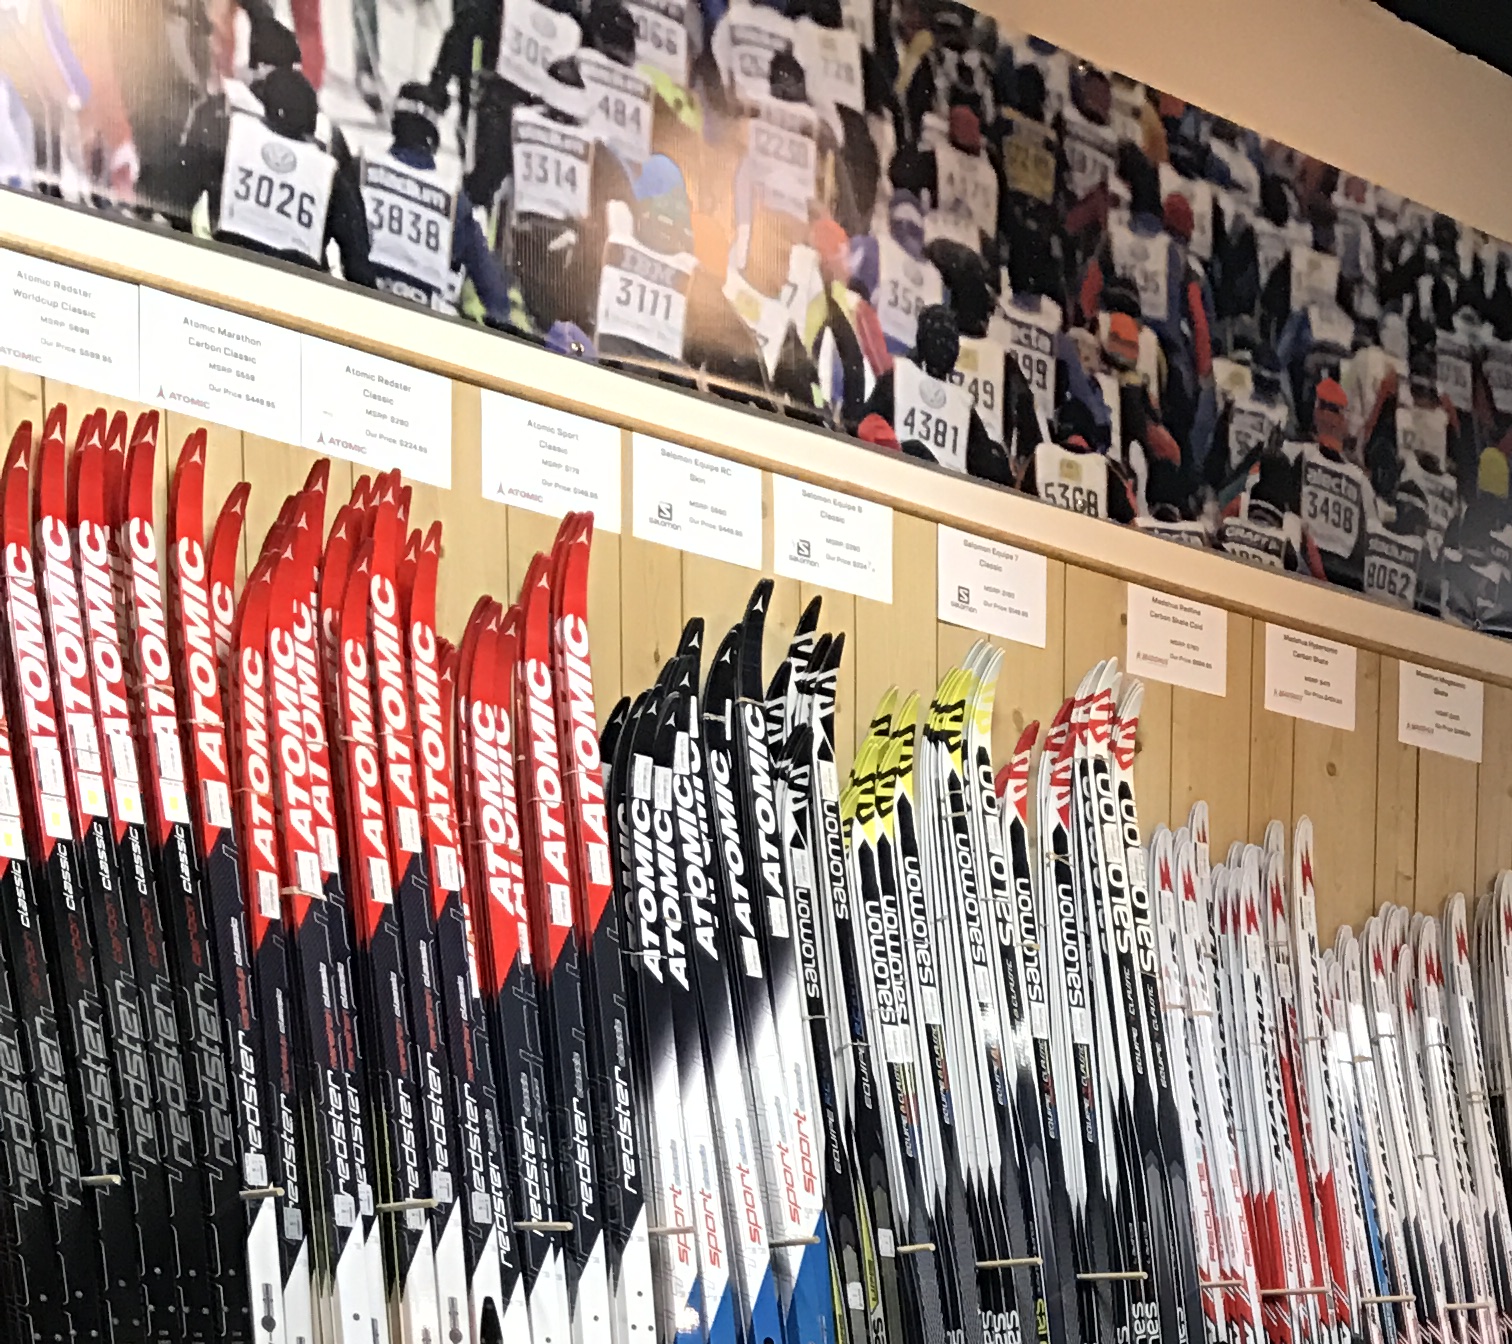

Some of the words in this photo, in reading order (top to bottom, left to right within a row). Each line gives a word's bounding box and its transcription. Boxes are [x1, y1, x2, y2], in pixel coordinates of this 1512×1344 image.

[234, 165, 316, 230] 3026
[521, 151, 577, 193] 3314
[368, 197, 441, 252] 3838
[13, 288, 59, 309] Worldcup
[61, 301, 97, 319] Classic
[16, 270, 51, 287] Atomic
[53, 279, 92, 299] Redster
[183, 316, 215, 334] Atomic
[217, 326, 262, 347] Marathon
[616, 277, 672, 321] 3111
[168, 391, 211, 410] ATOMIC
[188, 337, 222, 354] Carbon
[224, 346, 257, 365] Classic
[345, 365, 376, 382] Atomic
[377, 374, 412, 393] Redster
[363, 388, 394, 406] Classic
[328, 436, 367, 455] ATOMIC
[527, 419, 556, 436] Atomic
[556, 427, 580, 441] Sport
[539, 440, 569, 455] Classic
[660, 448, 693, 465] Salomon
[903, 407, 960, 456] 4381
[507, 487, 544, 503] ATOMIC
[801, 489, 832, 505] Salomon
[178, 536, 226, 777] ATOMIC
[370, 573, 422, 807] ATOMIC
[243, 646, 279, 871] ATOMIC
[270, 627, 316, 848] ATOMIC
[344, 638, 389, 857] ATOMIC
[410, 620, 457, 848] ATOMIC
[526, 658, 572, 882] ATOMIC
[562, 612, 612, 846] ATOMIC
[472, 699, 516, 918] ATOMIC
[711, 748, 752, 936] ATOMIC
[744, 703, 784, 901] ATOMIC
[174, 824, 194, 896] classic
[631, 799, 665, 985] ATOMIC
[654, 809, 691, 993] ATOMIC
[823, 800, 850, 921] salomon
[956, 831, 988, 965] salomon
[796, 886, 821, 1000] salomon
[866, 900, 895, 1025] salomon
[904, 855, 933, 986] salomon
[1014, 876, 1045, 1003] salomon
[1057, 882, 1085, 1008] salomon
[573, 1096, 596, 1222] redster
[615, 1067, 638, 1195] redster
[793, 1108, 818, 1199] sport
[699, 1187, 722, 1270] sport
[736, 1162, 762, 1246] sport
